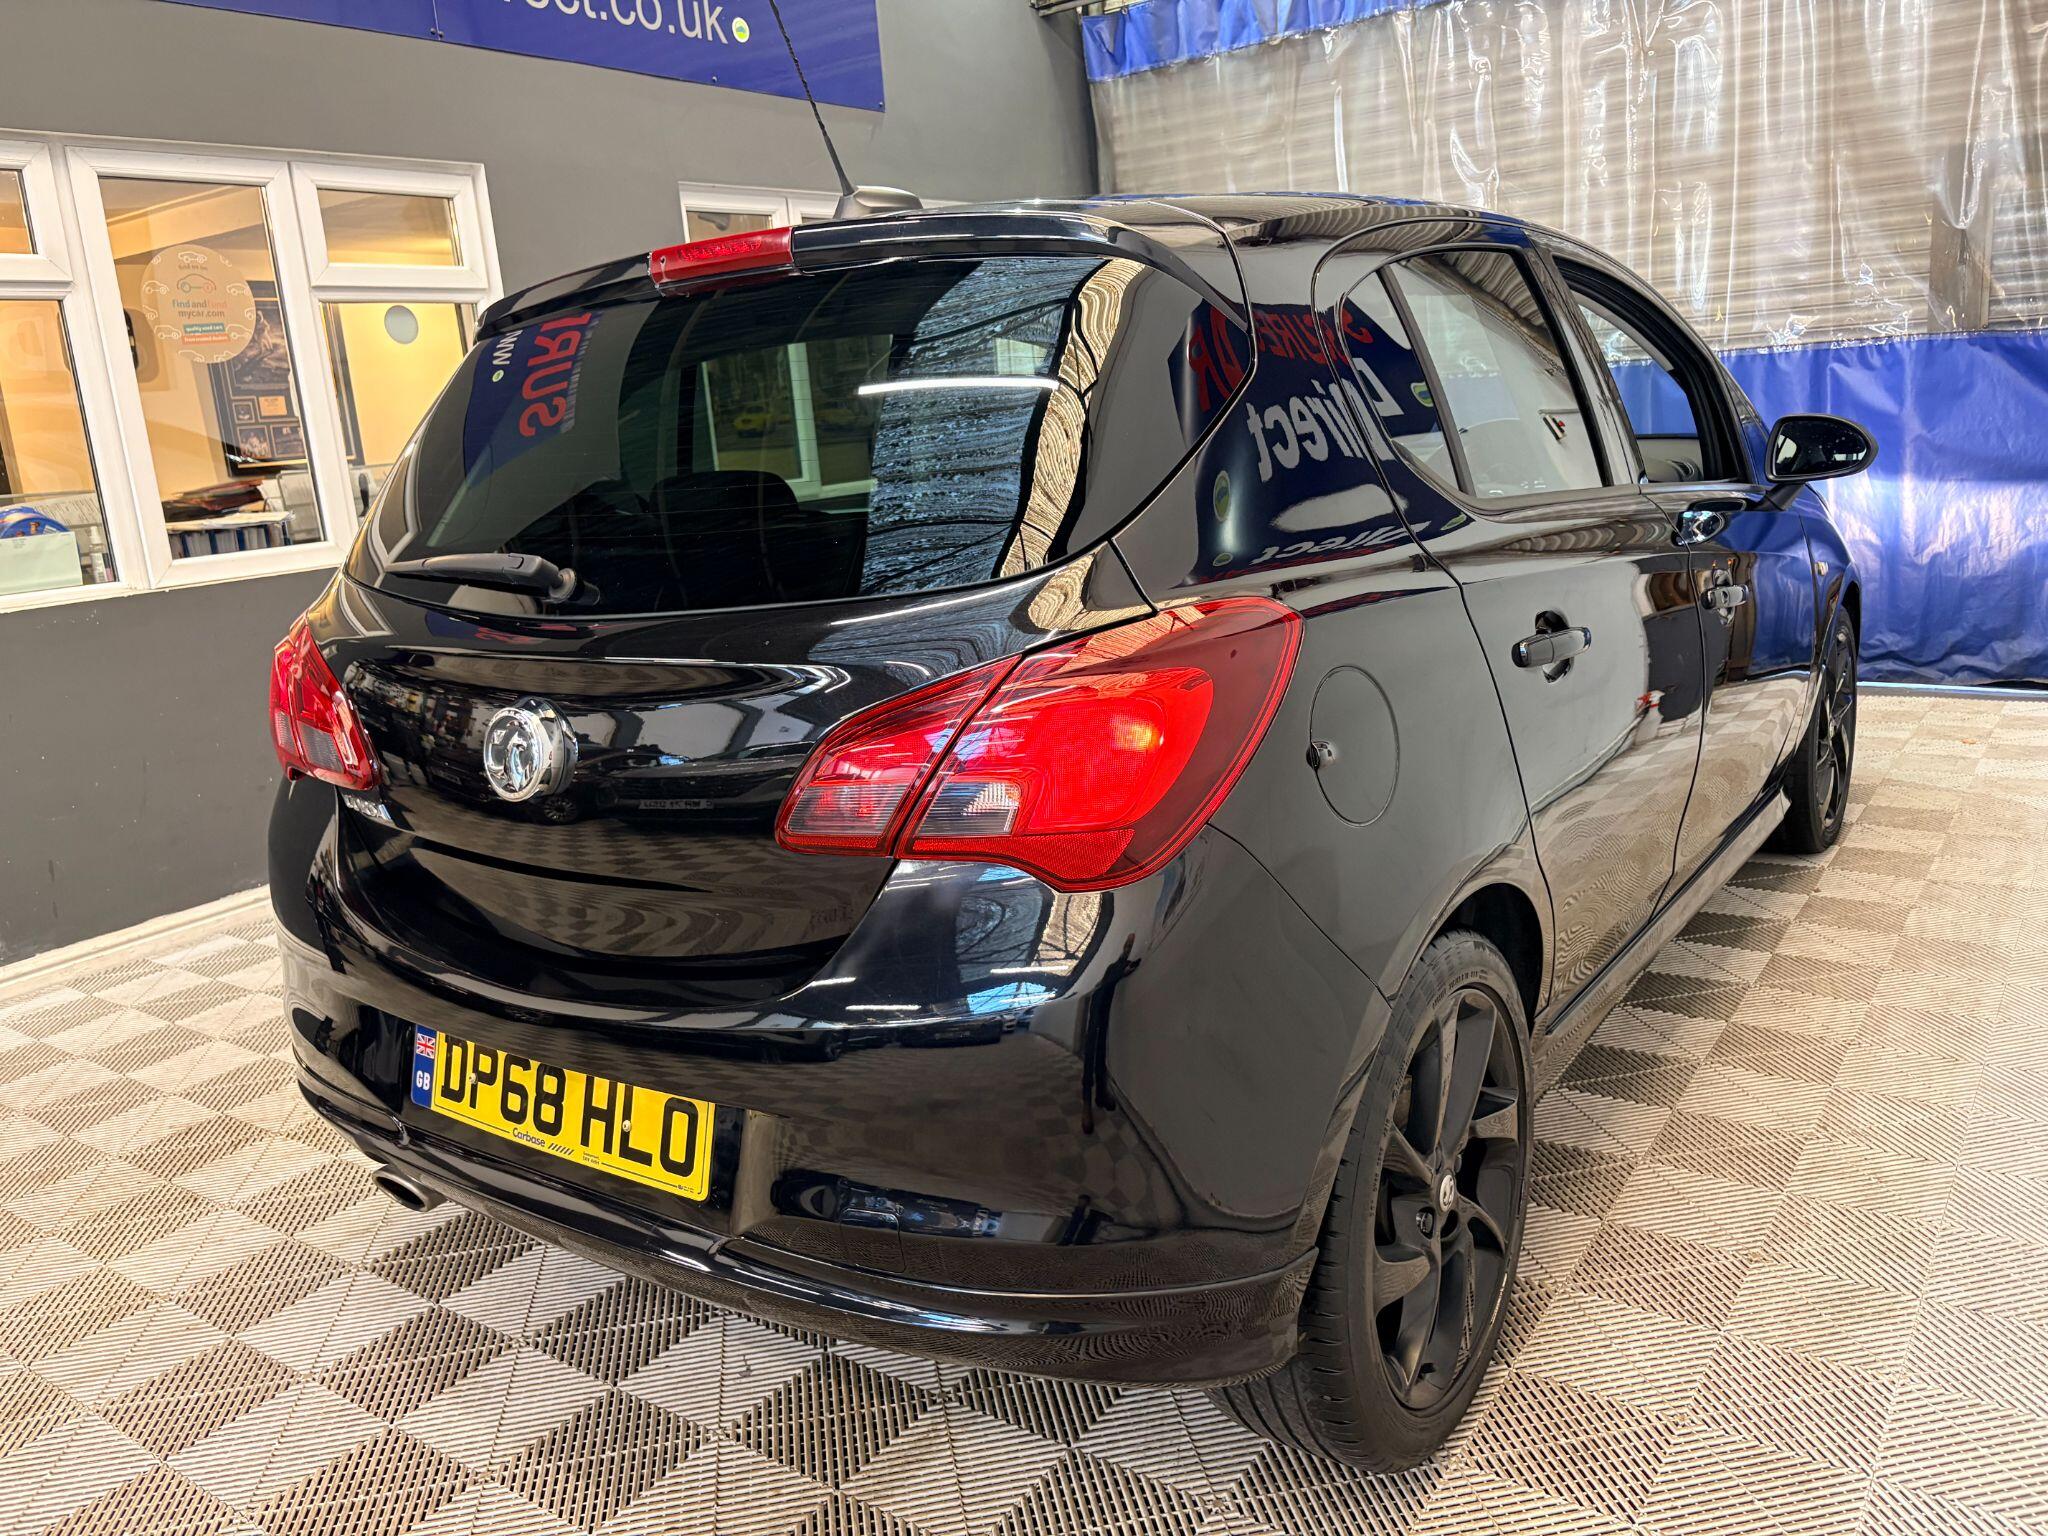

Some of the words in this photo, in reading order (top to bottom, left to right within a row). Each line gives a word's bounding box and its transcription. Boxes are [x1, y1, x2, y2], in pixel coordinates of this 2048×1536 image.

[178, 309, 226, 319] mycar.com
[416, 1070, 431, 1091] GB
[440, 1033, 567, 1137] DP68
[580, 1075, 699, 1178] HLO
[512, 1127, 546, 1147] Carbase
